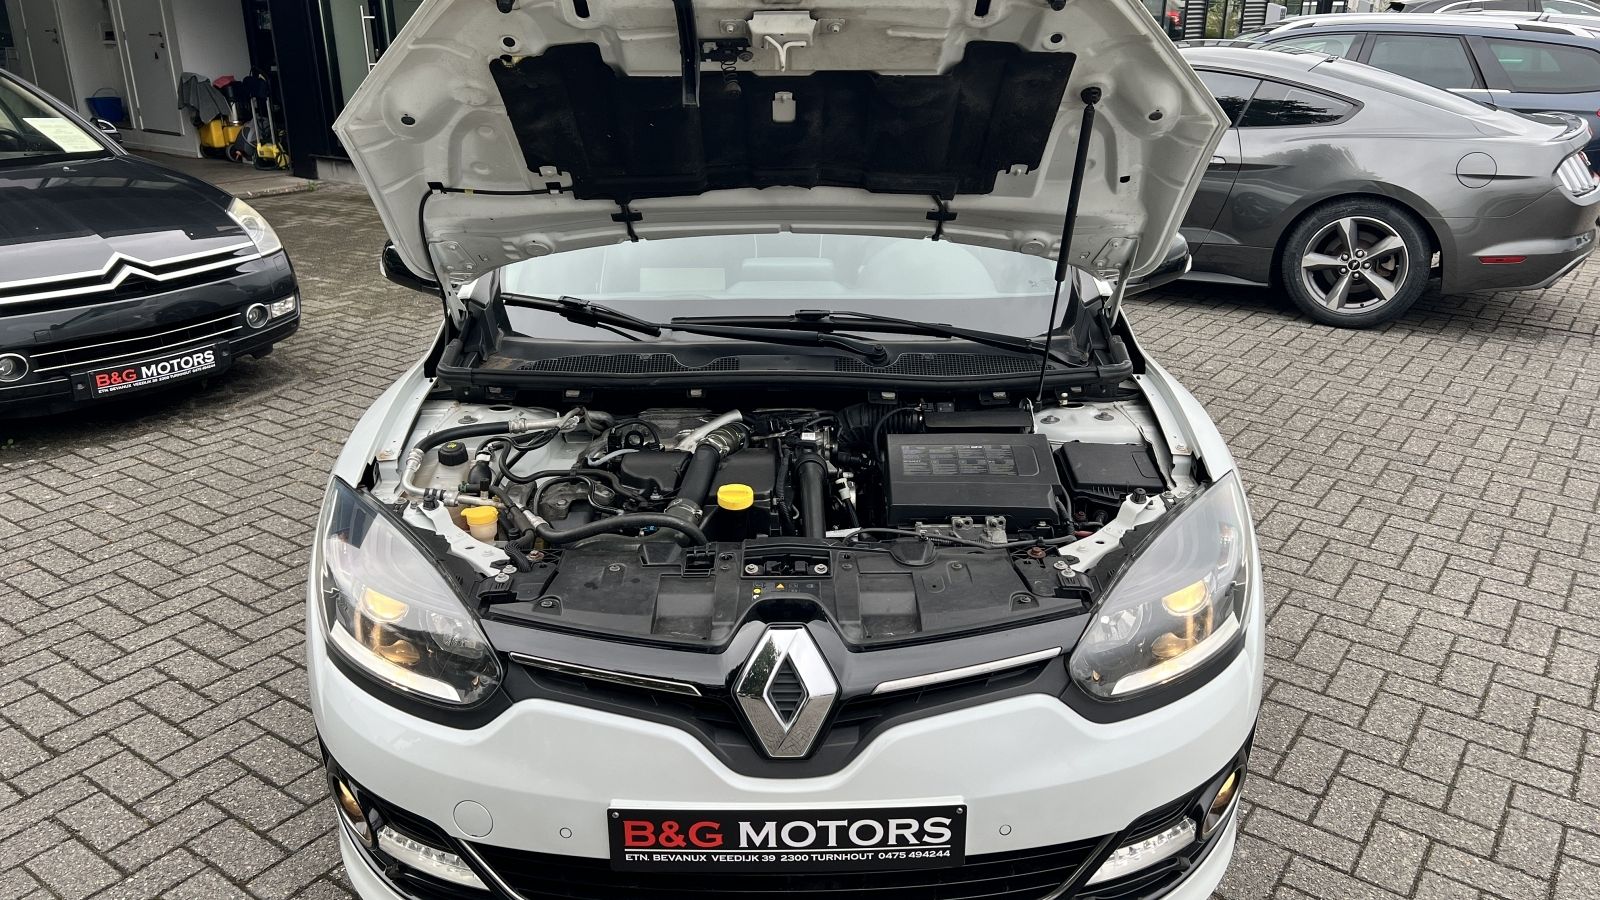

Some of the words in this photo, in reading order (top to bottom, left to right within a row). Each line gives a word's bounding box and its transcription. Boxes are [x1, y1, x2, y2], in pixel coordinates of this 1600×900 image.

[95, 369, 137, 387] B&G
[141, 350, 215, 378] MOTORS
[622, 820, 724, 848] B&G
[738, 816, 952, 848] MOTORS
[625, 853, 650, 861] ETN.
[652, 853, 707, 862] BEVANUX
[711, 854, 760, 862] VEEDIJK
[761, 854, 776, 862] 39
[780, 854, 809, 862] 2300
[810, 852, 874, 862] TURNHOUT
[878, 851, 906, 860] 0475
[908, 850, 951, 859] 494244
